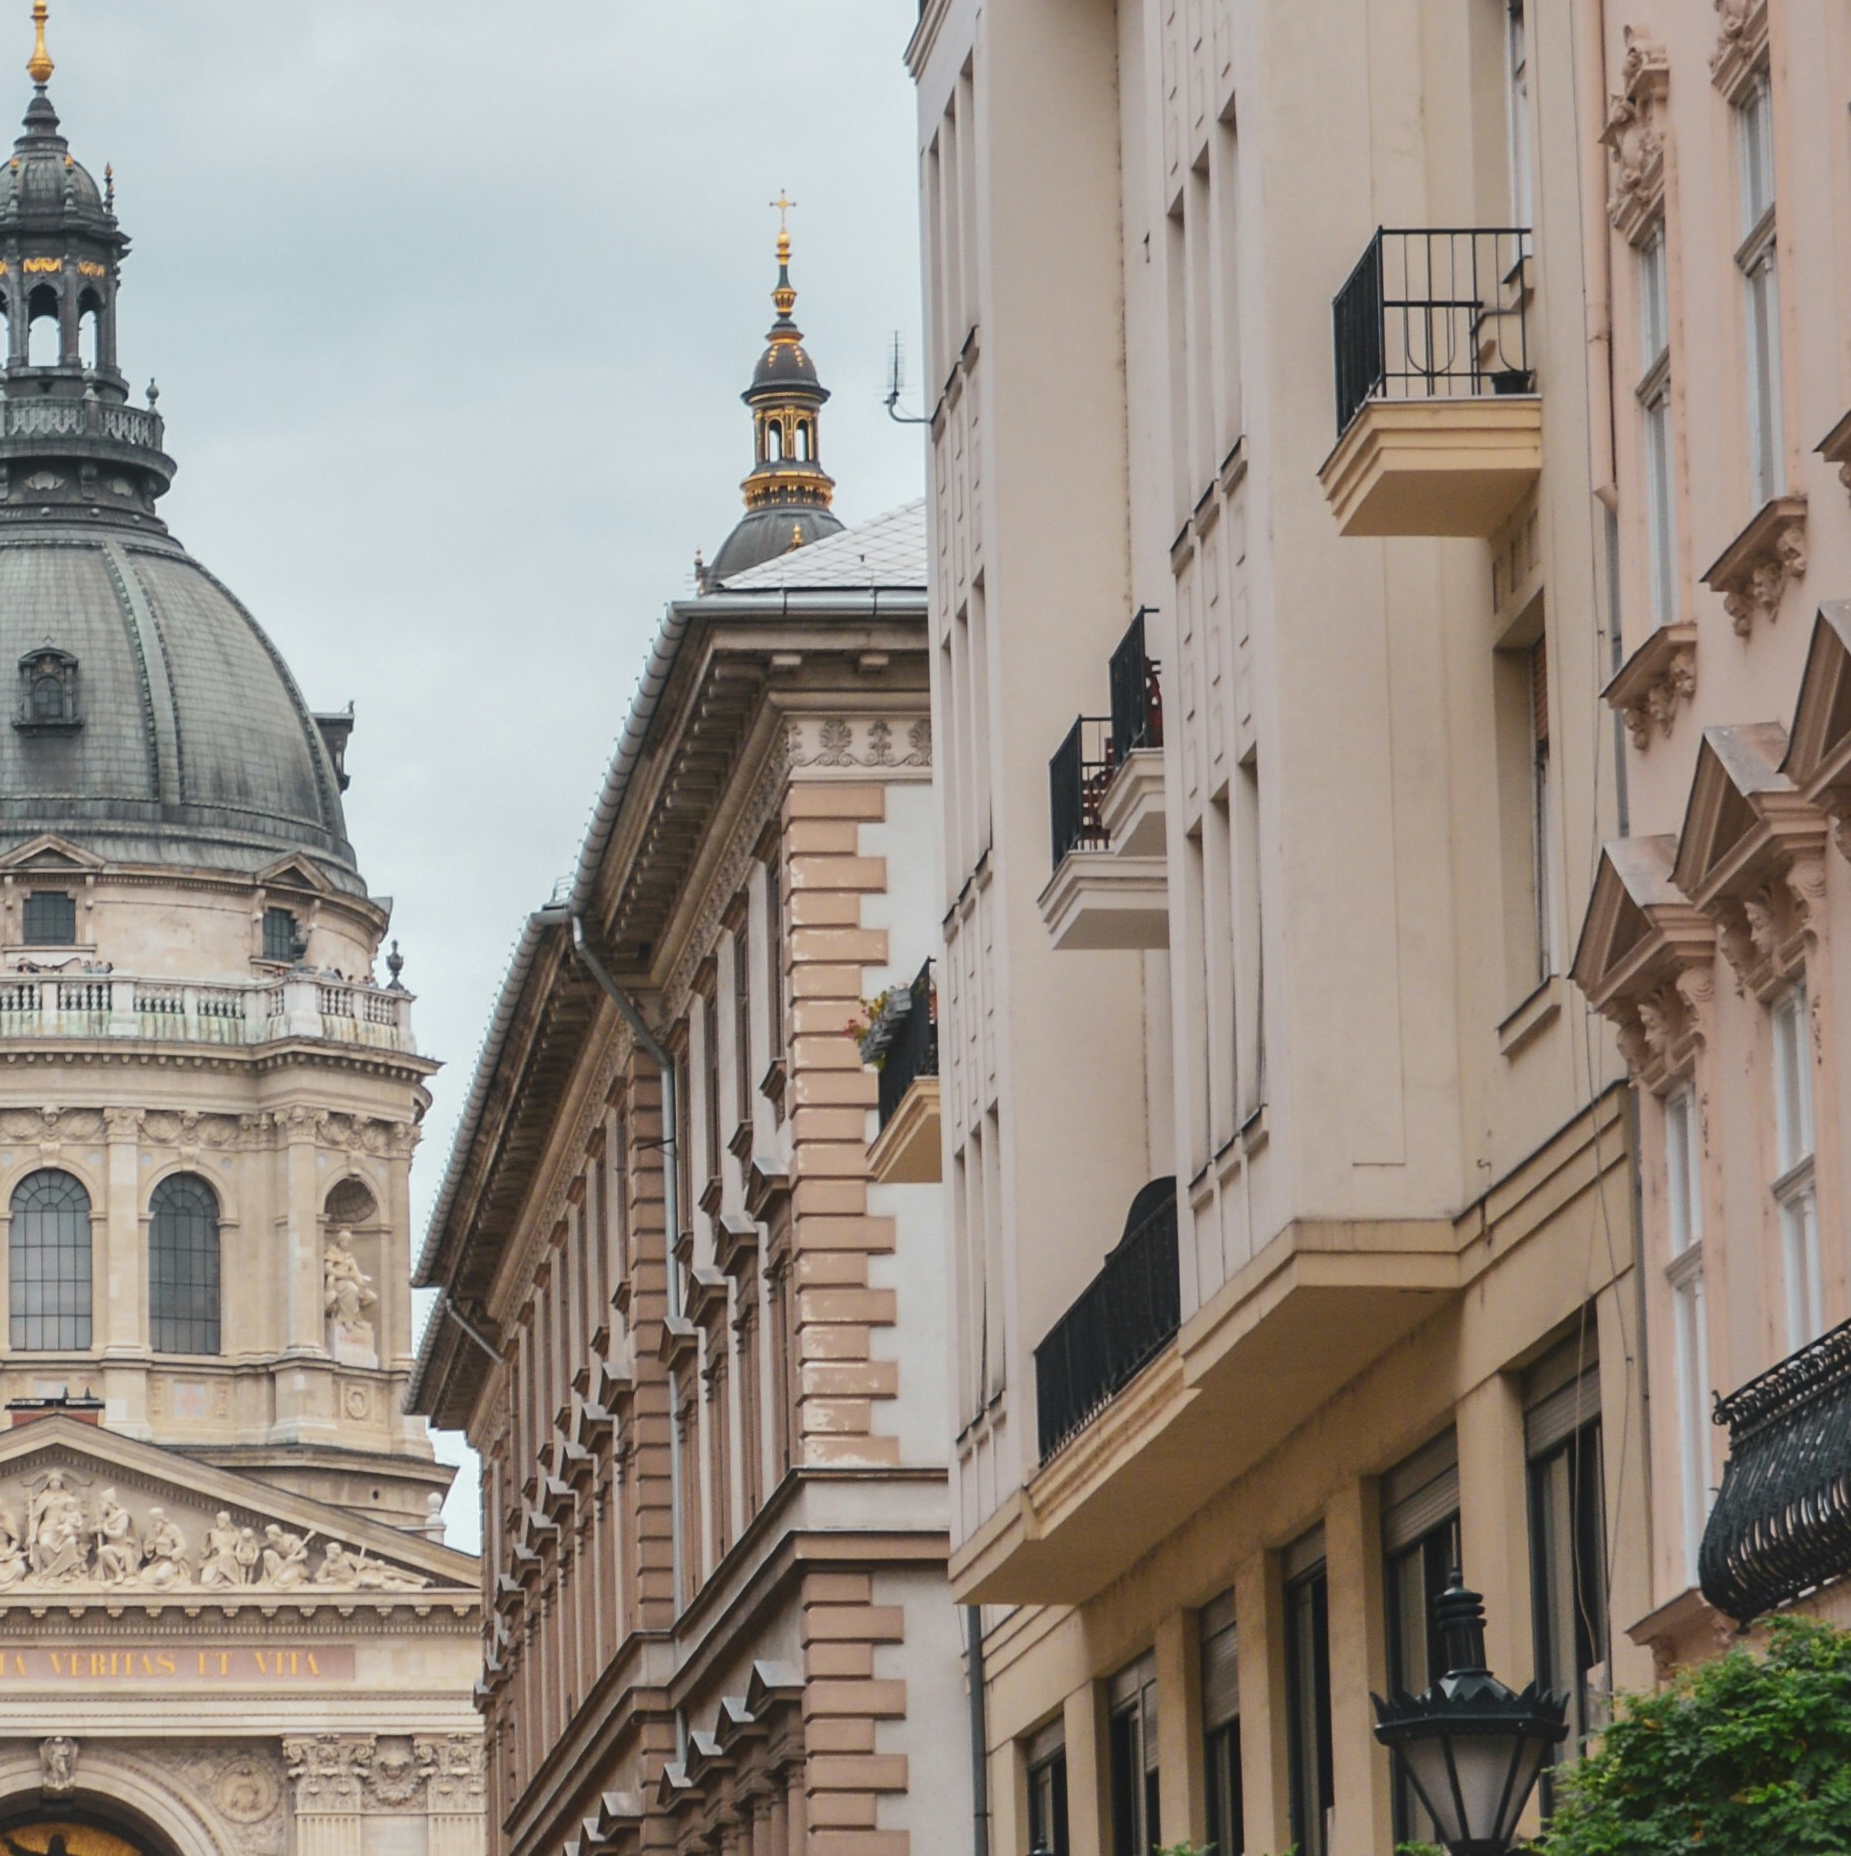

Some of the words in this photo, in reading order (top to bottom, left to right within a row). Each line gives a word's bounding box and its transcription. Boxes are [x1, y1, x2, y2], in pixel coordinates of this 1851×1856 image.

[49, 1651, 178, 1677] VERITAS
[197, 1651, 233, 1676] ET
[253, 1651, 321, 1676] VITA
